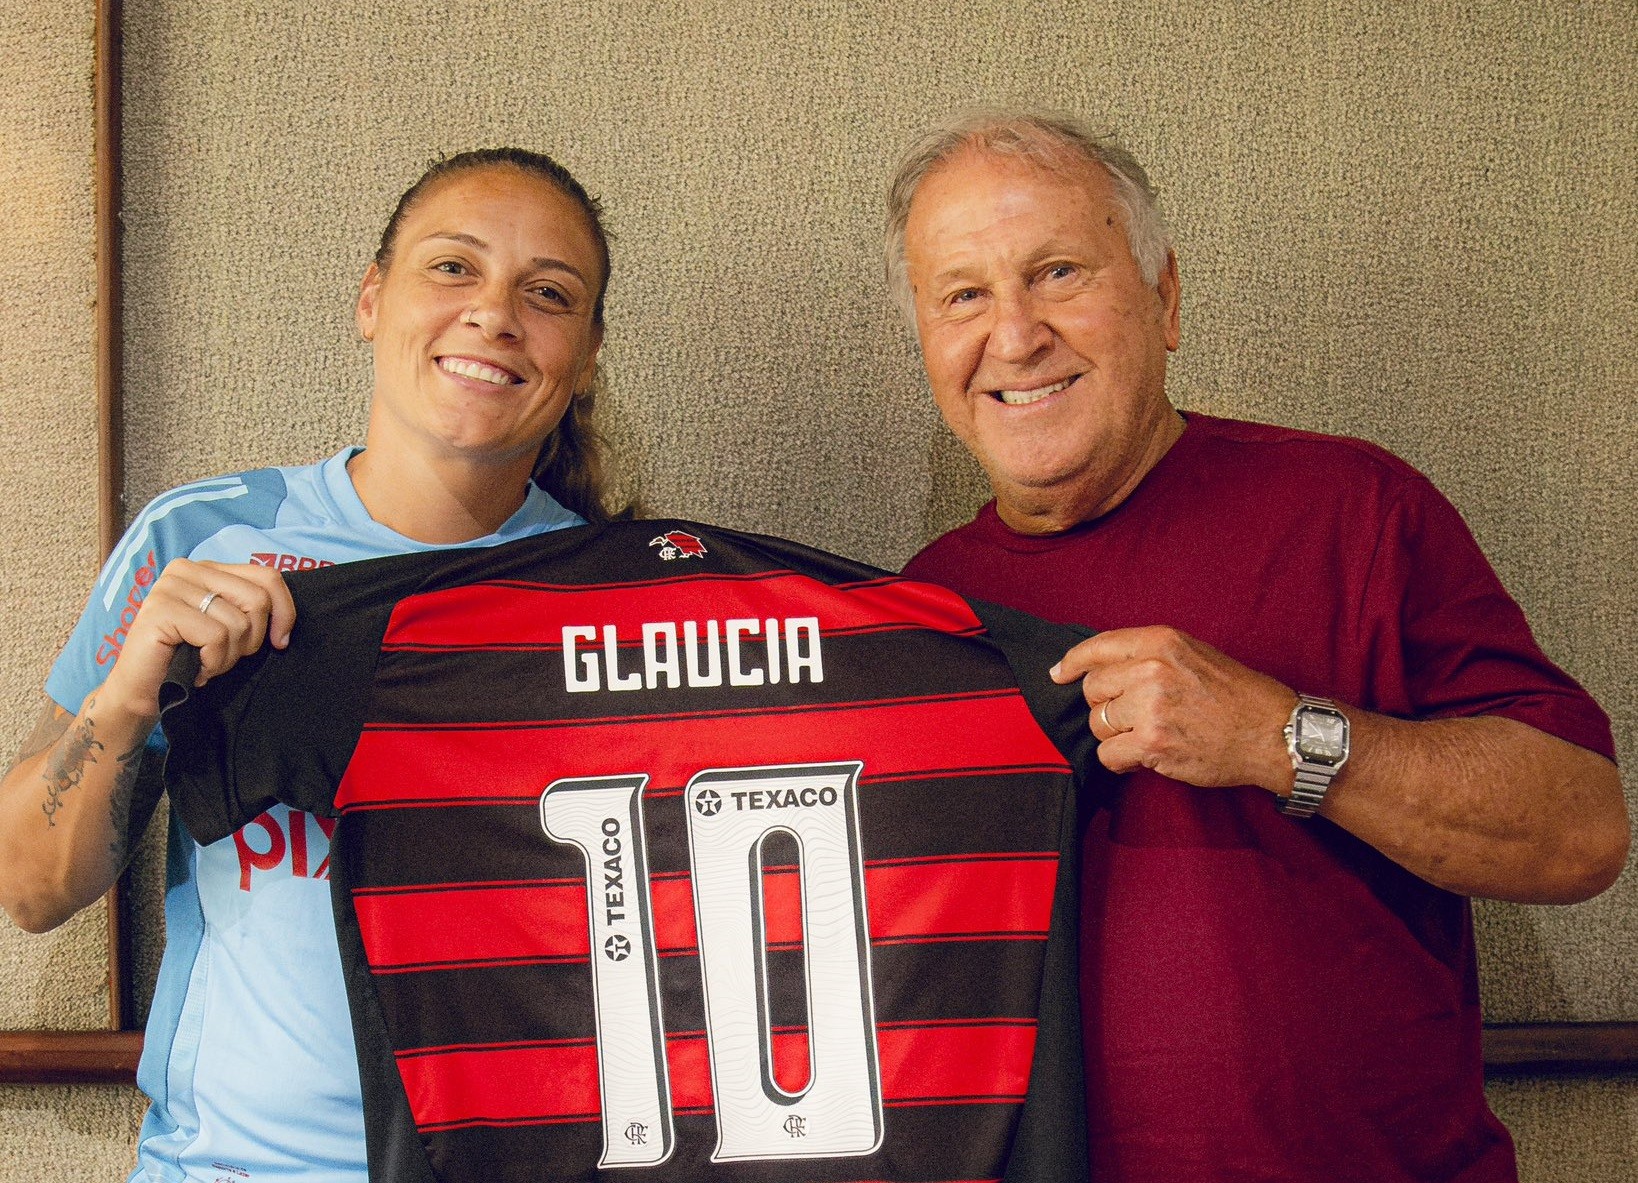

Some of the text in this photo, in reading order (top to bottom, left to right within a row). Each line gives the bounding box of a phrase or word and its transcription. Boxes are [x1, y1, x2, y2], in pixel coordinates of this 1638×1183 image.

[561, 617, 824, 693] GLAUCIA
[730, 786, 838, 811] TEXACO
[601, 817, 626, 926] TEXACO
[540, 761, 885, 1170] 10
